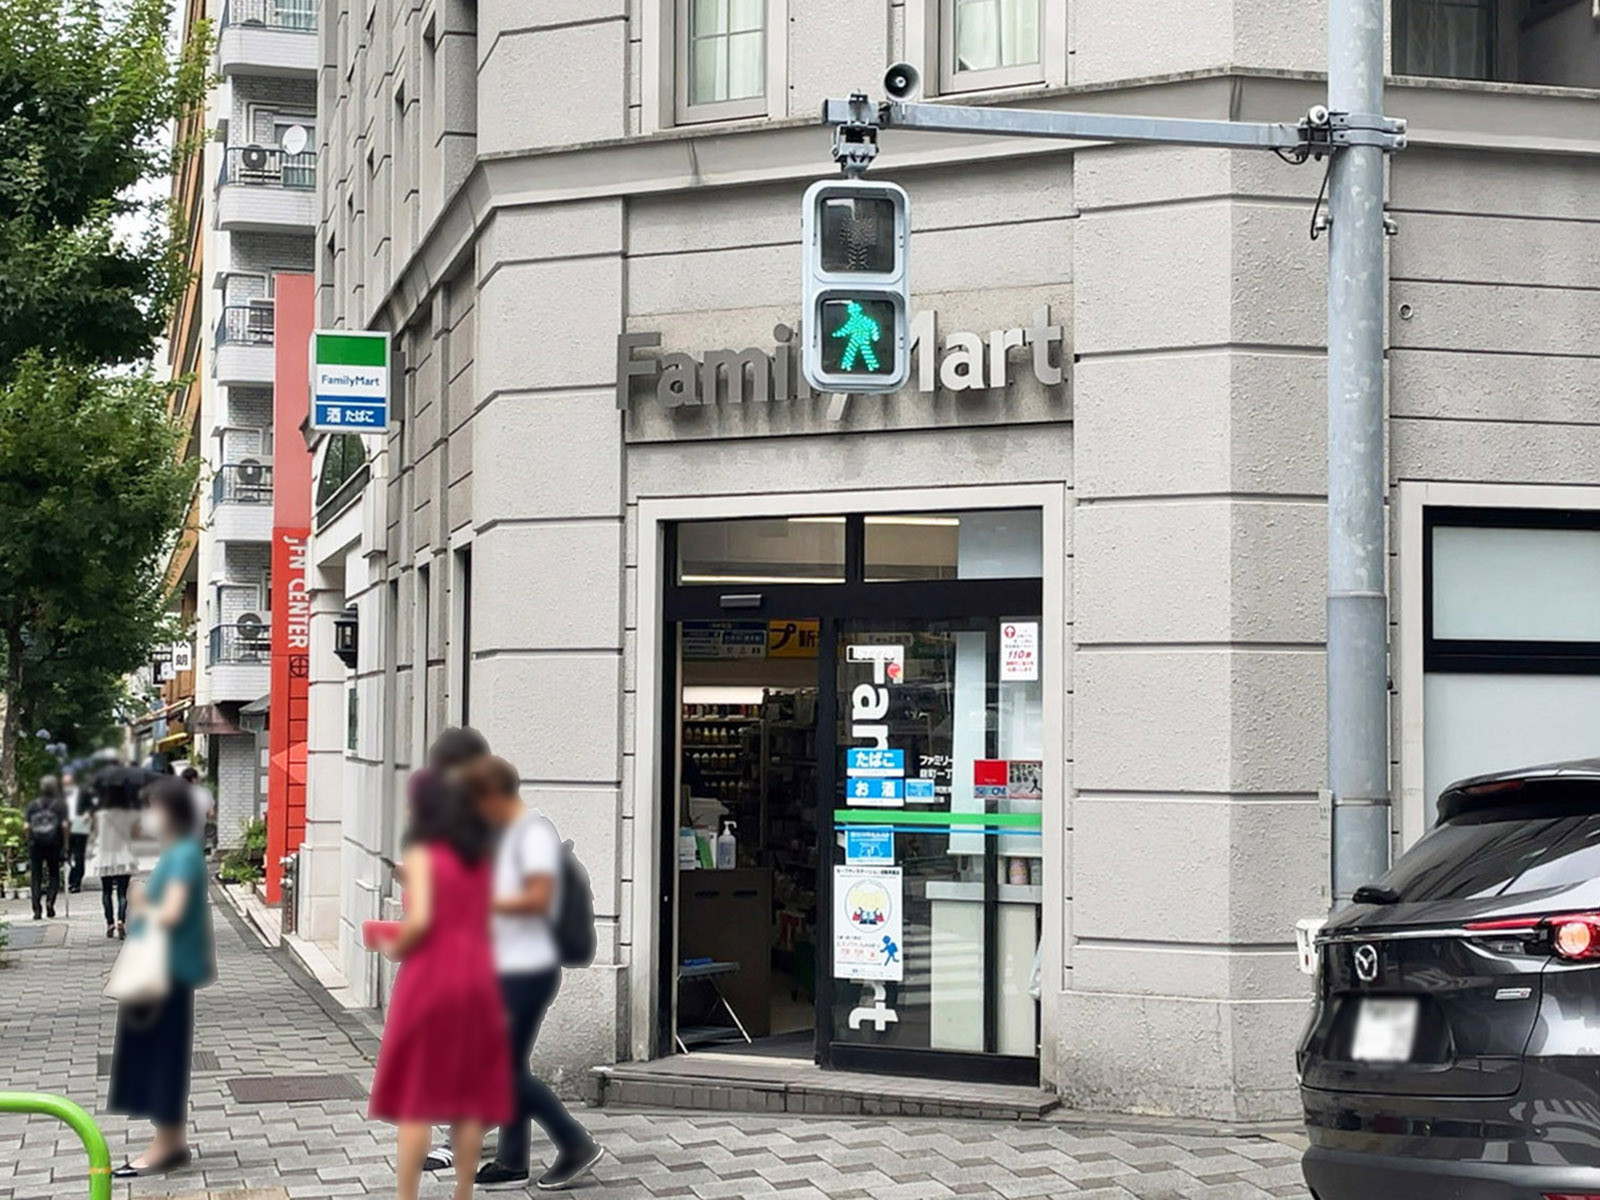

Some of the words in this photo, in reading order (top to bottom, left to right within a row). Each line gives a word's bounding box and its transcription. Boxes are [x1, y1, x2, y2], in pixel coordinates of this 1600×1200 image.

[321, 375, 380, 387] FamilyMart
[326, 407, 341, 423] 酒
[345, 409, 375, 423] たばこ
[283, 535, 307, 570] JFN
[288, 577, 309, 648] CENTER
[855, 752, 895, 768] たばこ
